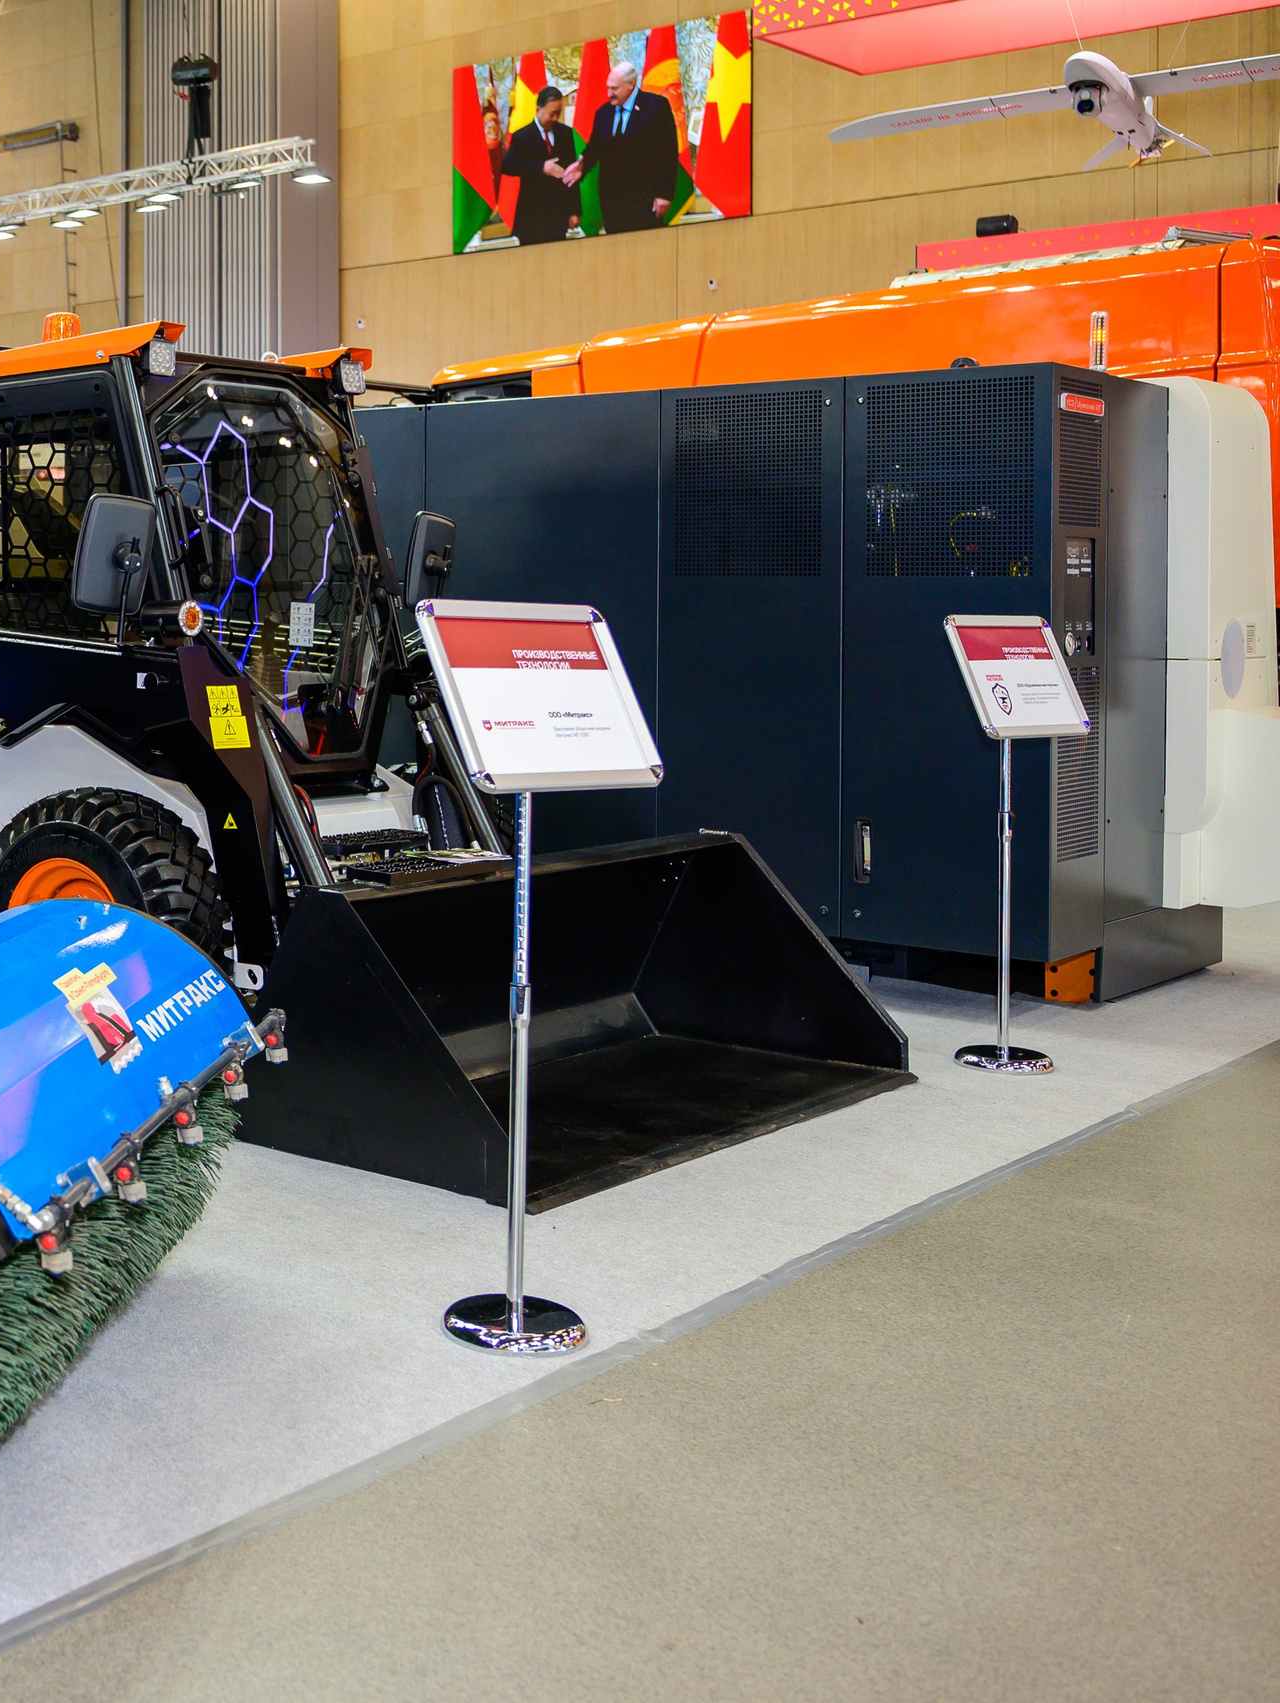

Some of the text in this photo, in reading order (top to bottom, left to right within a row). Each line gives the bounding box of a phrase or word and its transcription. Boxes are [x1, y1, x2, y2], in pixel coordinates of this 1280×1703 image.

[511, 649, 599, 661] ПРОИЗВОДСТВЕННЫЕ
[516, 661, 572, 670] ТЕХНОЛОГИИ
[548, 711, 562, 719] ООО
[493, 720, 535, 728] МИТРАКС
[135, 968, 227, 1043] МИТРАКС
